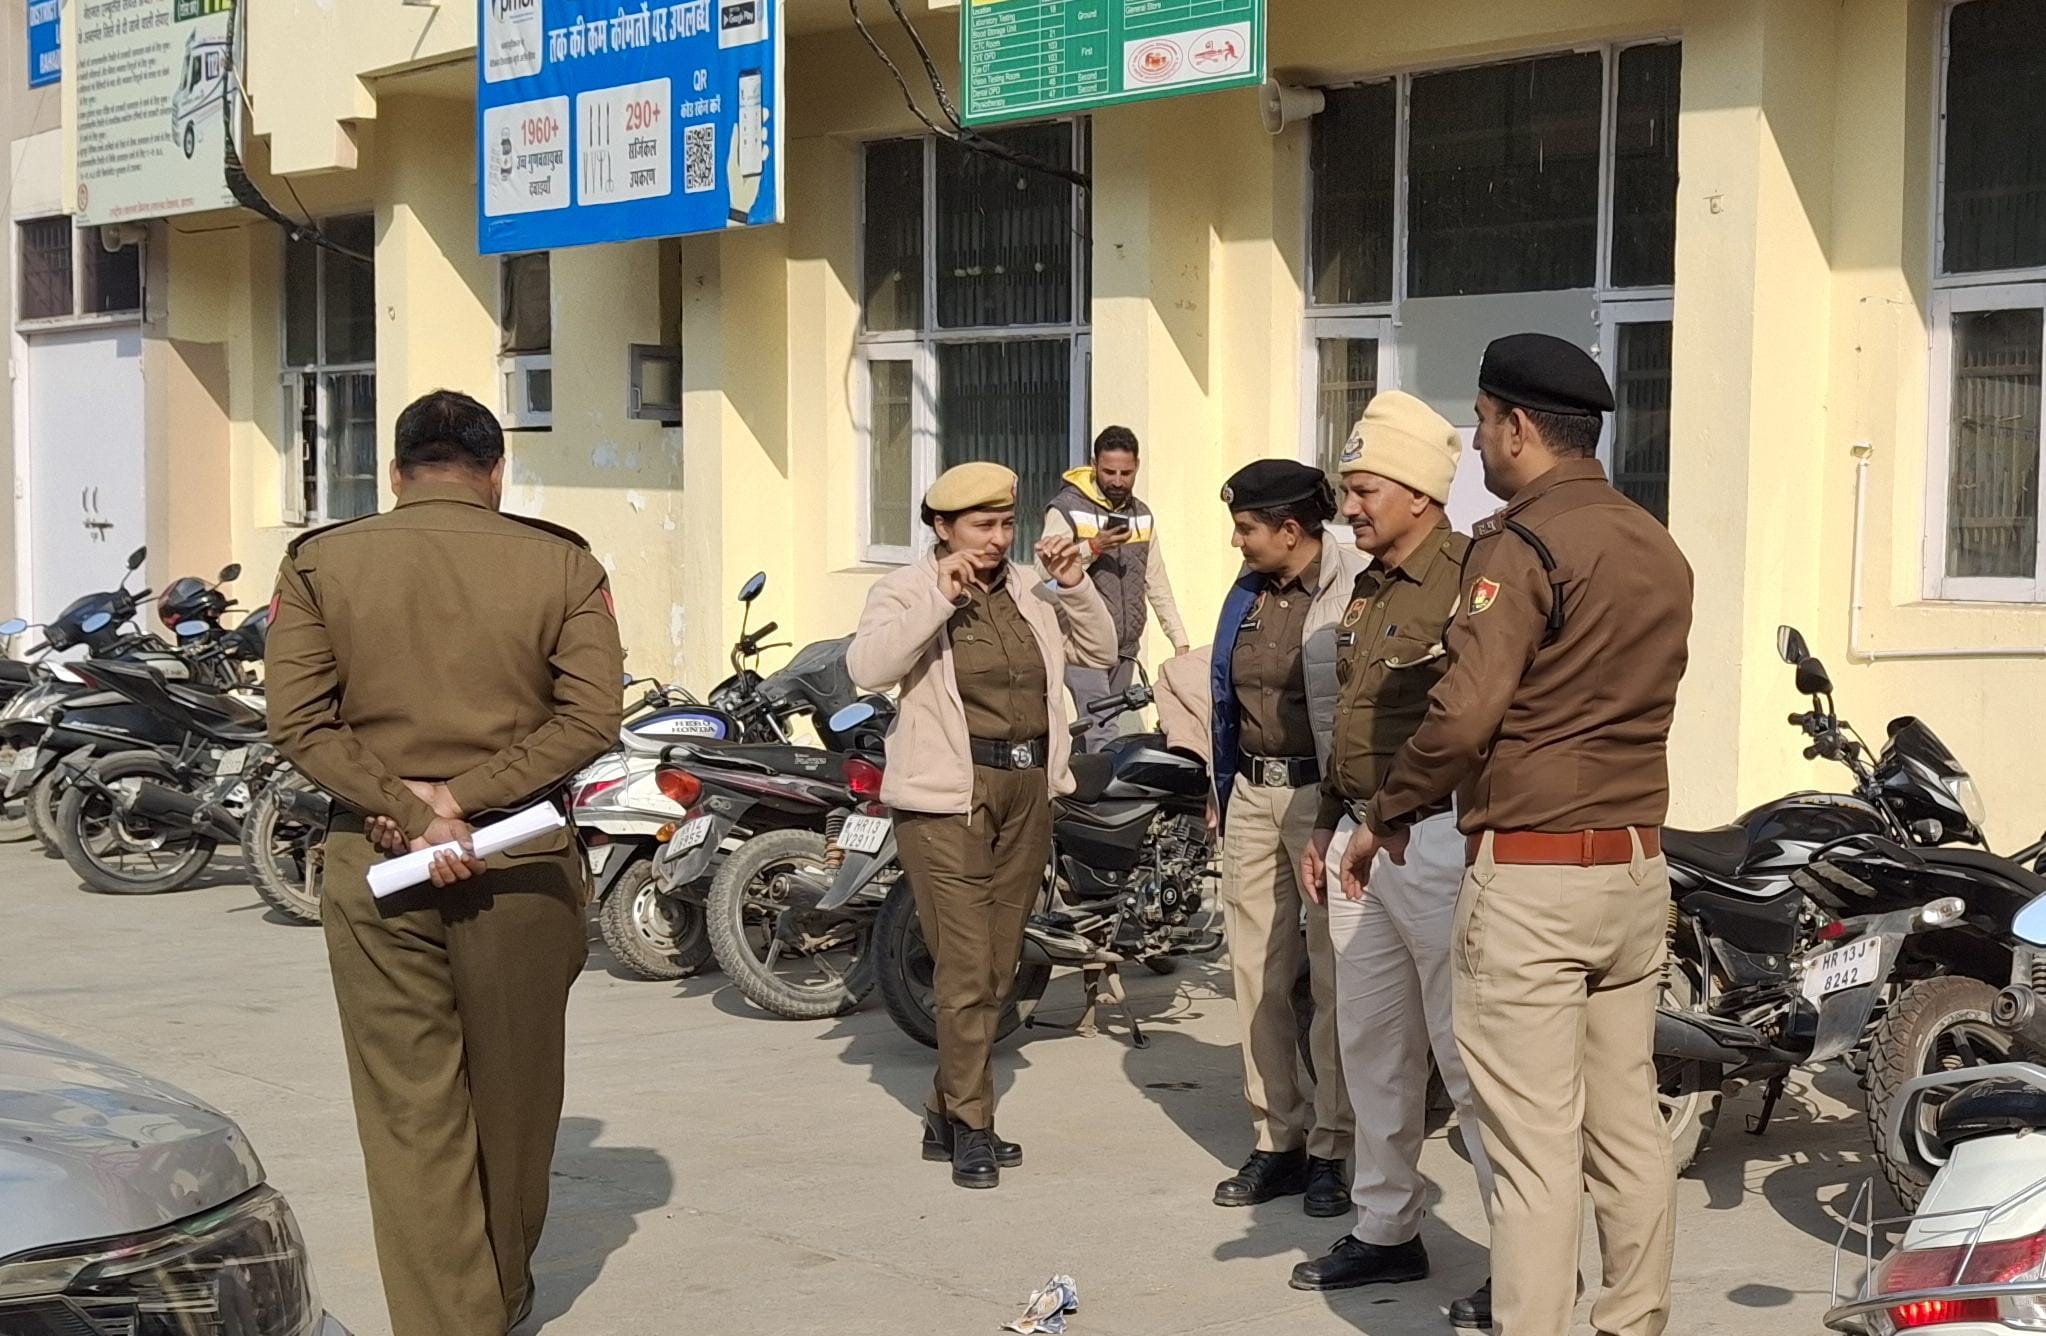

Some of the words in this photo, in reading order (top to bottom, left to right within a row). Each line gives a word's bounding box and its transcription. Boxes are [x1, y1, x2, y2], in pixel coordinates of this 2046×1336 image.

[1077, 10, 1098, 21] Ground
[569, 15, 586, 58] की
[653, 8, 668, 43] पर
[1081, 47, 1093, 56] First
[693, 69, 707, 92] QR
[625, 100, 661, 132] 290+
[521, 115, 559, 147] 1960+
[855, 818, 881, 834] HR13
[1822, 951, 1839, 970] HR
[1824, 967, 1858, 991] 8242
